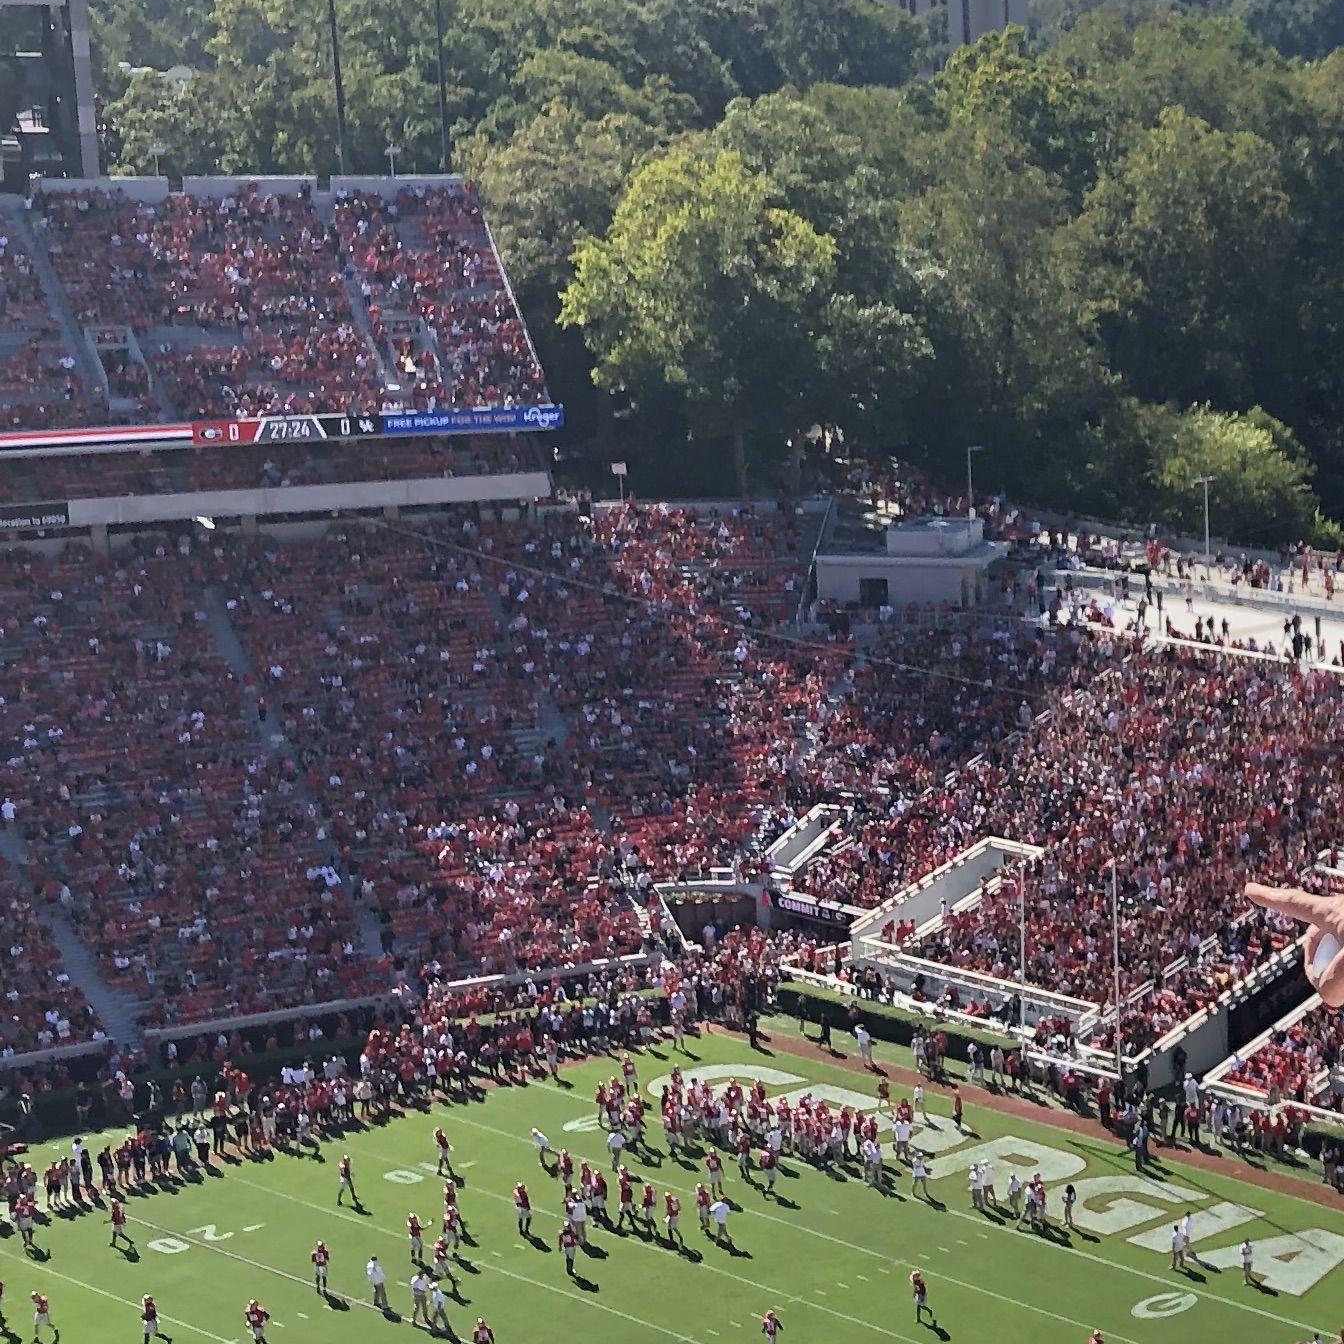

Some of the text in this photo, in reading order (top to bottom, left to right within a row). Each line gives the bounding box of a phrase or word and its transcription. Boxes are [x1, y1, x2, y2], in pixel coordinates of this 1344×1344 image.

[269, 419, 311, 440] 27:24
[387, 418, 412, 429] FREE
[414, 416, 449, 428] PICKUP
[778, 897, 820, 917] COMMIT
